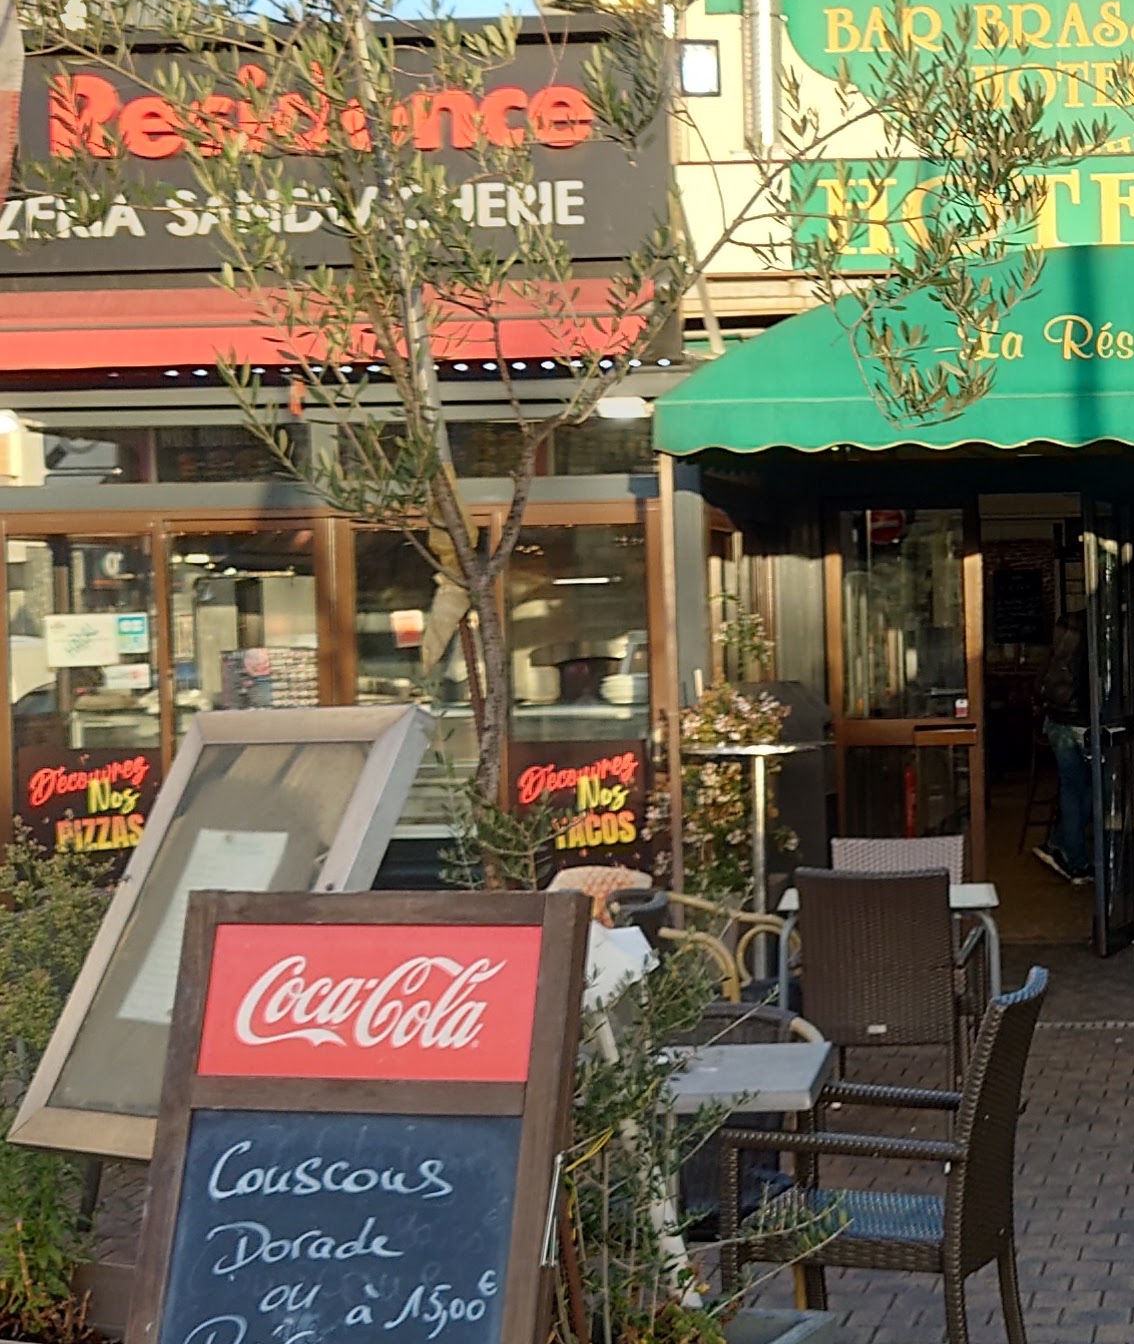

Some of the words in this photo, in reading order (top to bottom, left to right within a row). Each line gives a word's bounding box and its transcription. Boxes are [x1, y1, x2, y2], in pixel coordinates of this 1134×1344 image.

[823, 5, 943, 53] BAR
[956, 311, 1025, 361] La
[87, 777, 141, 814] Nos
[577, 774, 631, 812] Nos
[55, 812, 145, 853] PIZZAS
[233, 954, 508, 1049] Coca-Cola
[209, 1140, 454, 1201] Couscous
[206, 1216, 405, 1276] Dorade
[259, 1281, 323, 1312] ou
